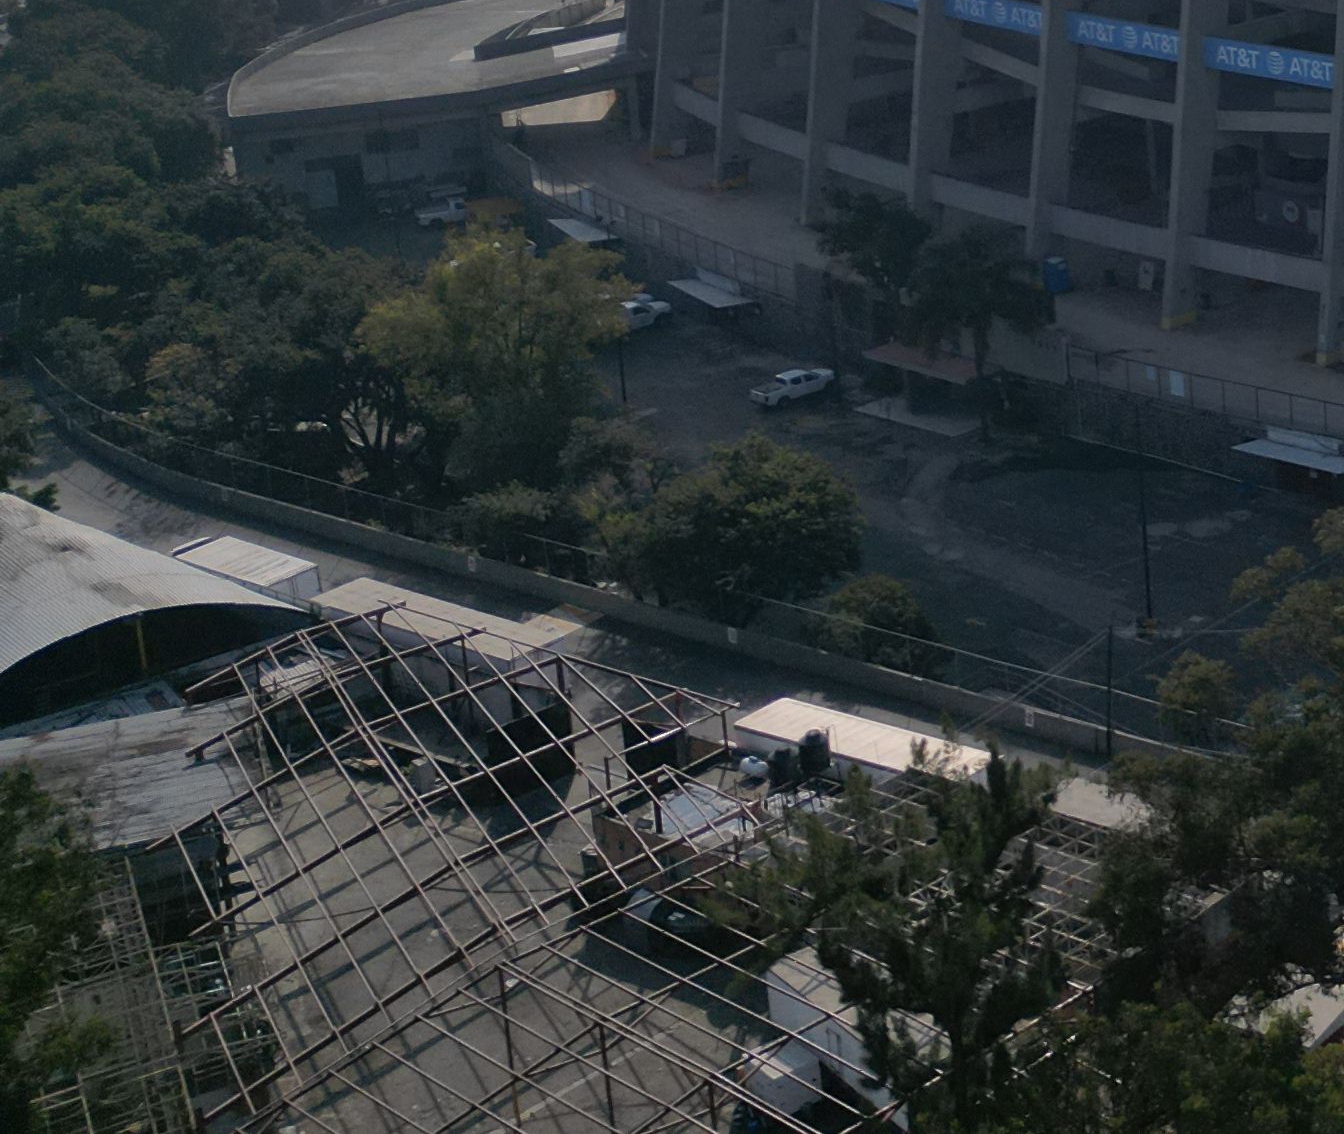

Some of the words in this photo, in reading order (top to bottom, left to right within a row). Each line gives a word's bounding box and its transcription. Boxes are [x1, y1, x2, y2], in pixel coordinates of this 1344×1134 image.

[1078, 20, 1116, 44] AT&T
[1141, 31, 1179, 55] AT&T
[1216, 46, 1260, 70] AT&T
[1289, 57, 1334, 82] AT&T
